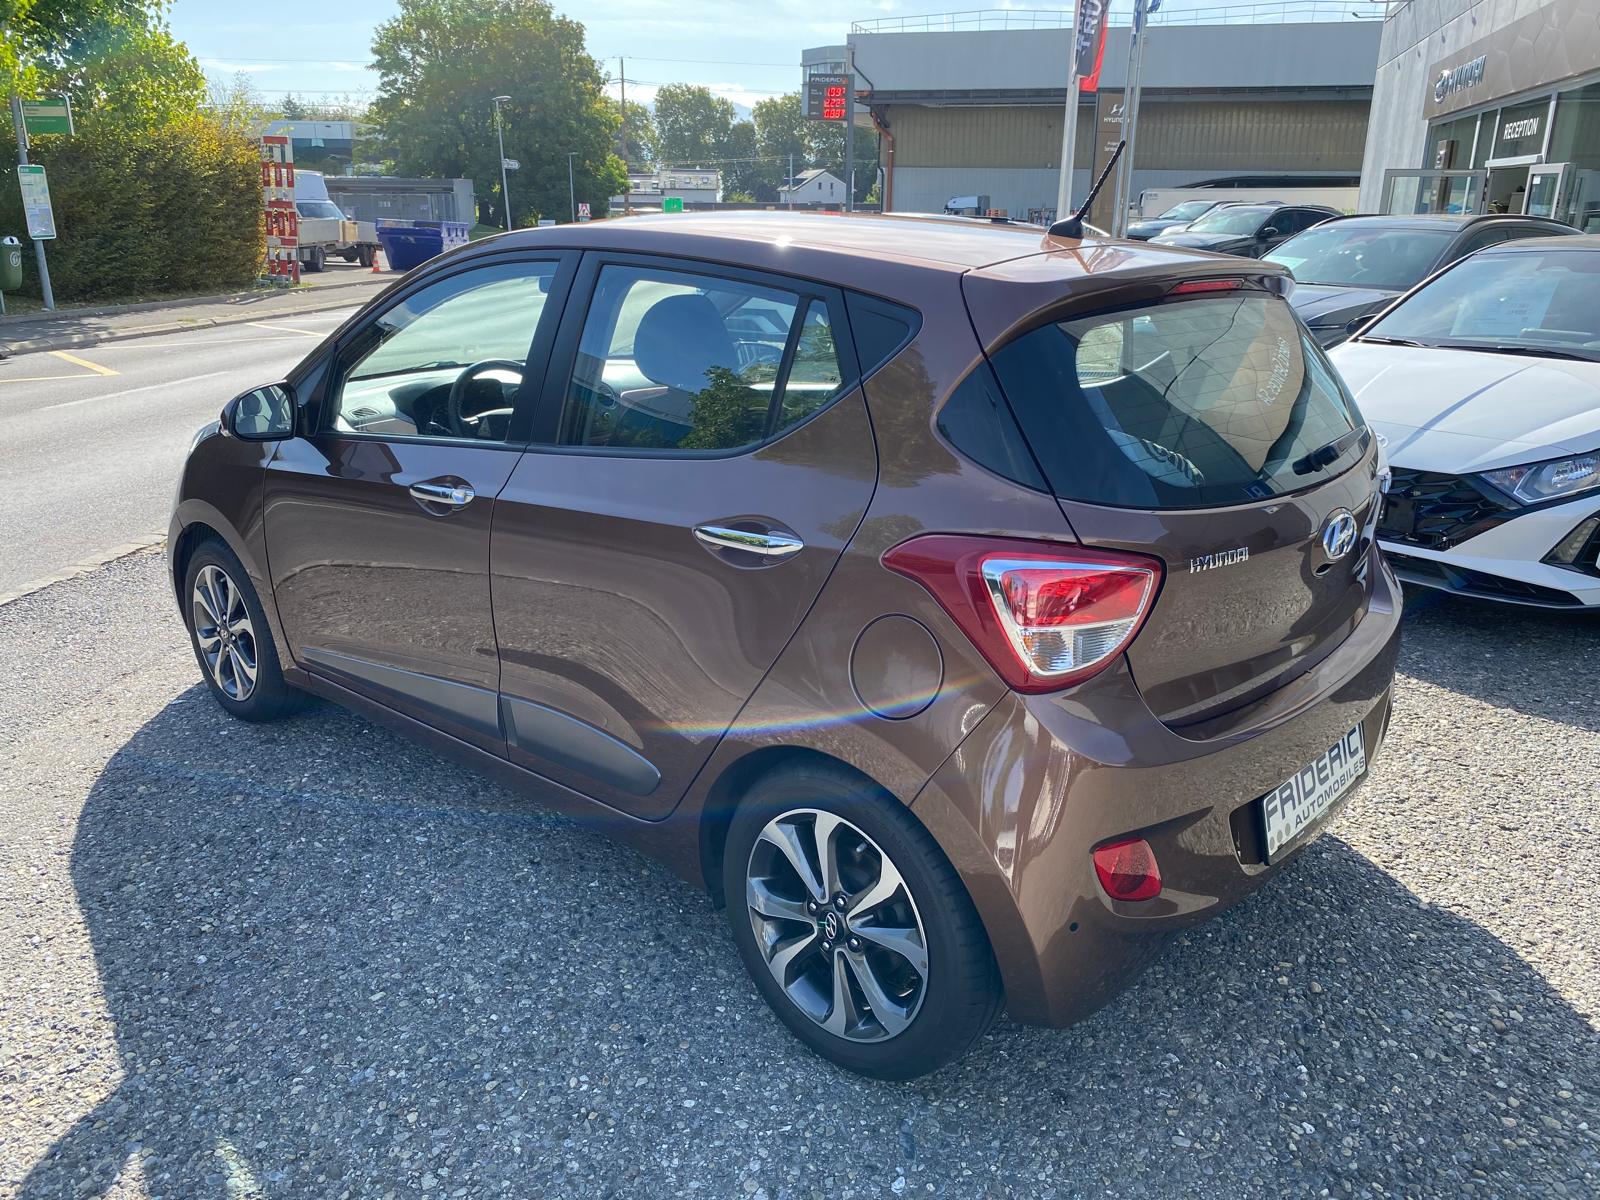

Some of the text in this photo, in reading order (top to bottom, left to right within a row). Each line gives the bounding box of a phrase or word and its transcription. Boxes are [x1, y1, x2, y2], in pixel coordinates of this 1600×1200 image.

[1447, 54, 1487, 95] HYUNDAI
[1503, 117, 1539, 140] RECEPTION
[1190, 547, 1249, 574] HYUNDAI
[1265, 722, 1364, 832] FRIDERICI
[1294, 756, 1366, 829] AUTOMOBILES
